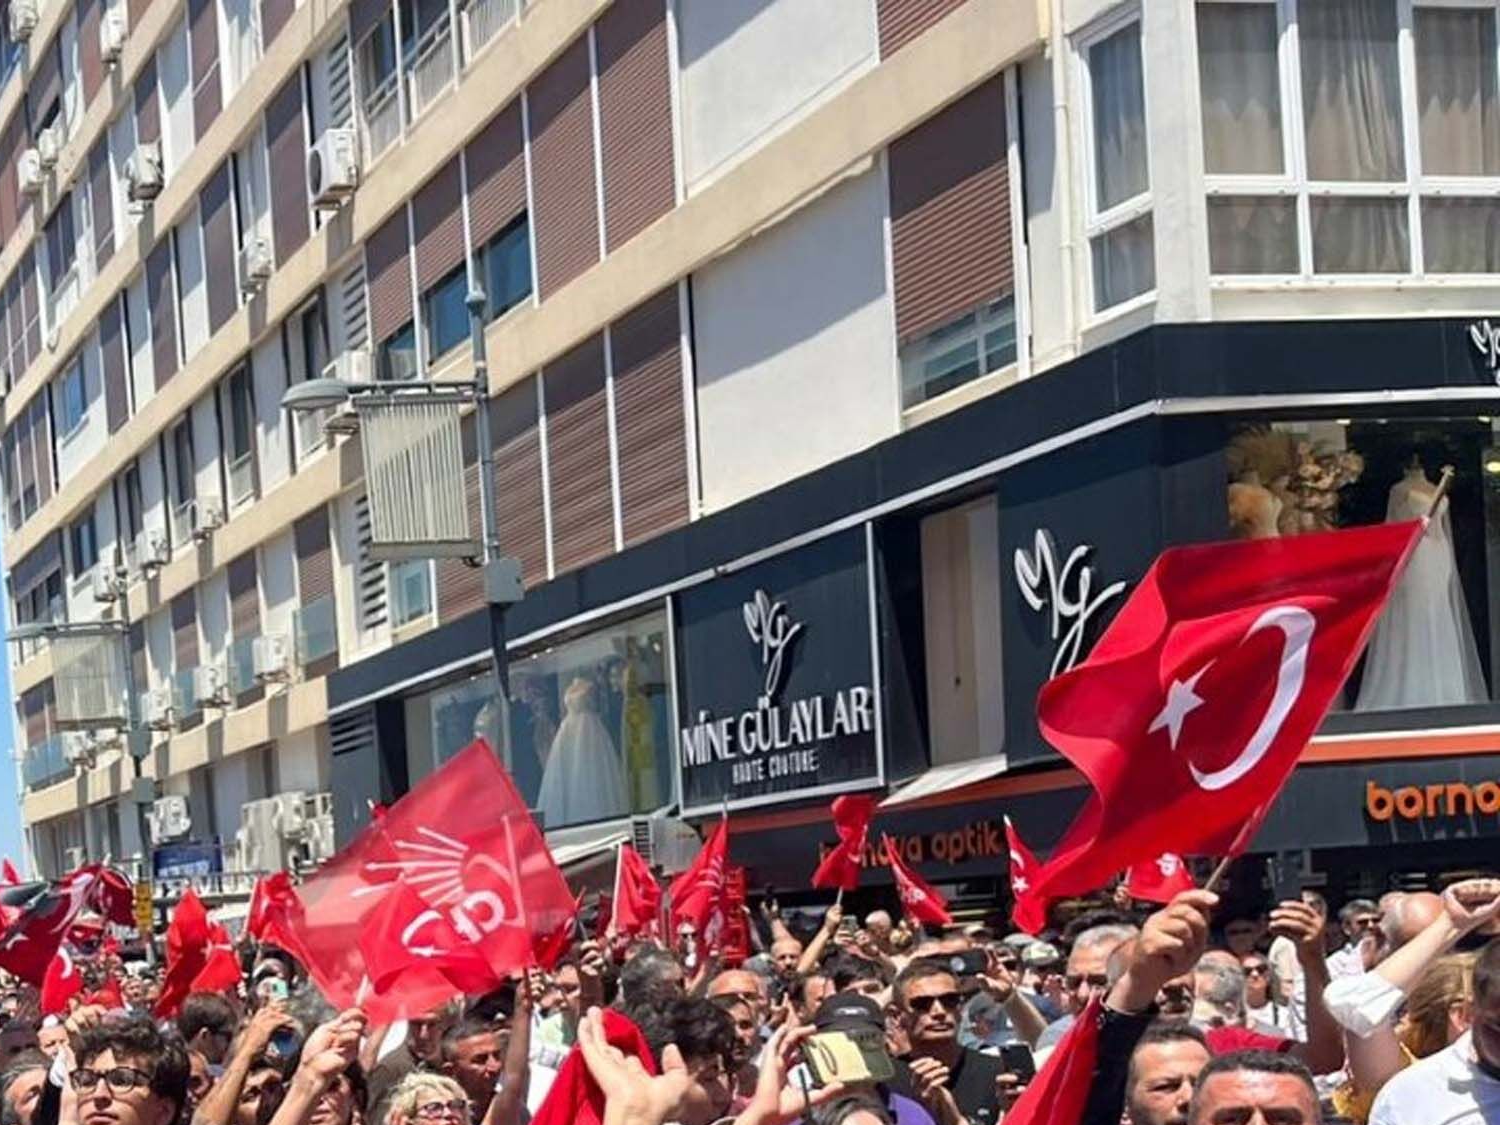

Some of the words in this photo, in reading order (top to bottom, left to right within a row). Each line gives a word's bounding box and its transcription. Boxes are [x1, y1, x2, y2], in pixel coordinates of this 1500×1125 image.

[682, 710, 737, 768] MİNE
[739, 686, 871, 755] GÜLAYLAR
[931, 821, 1000, 864] optik
